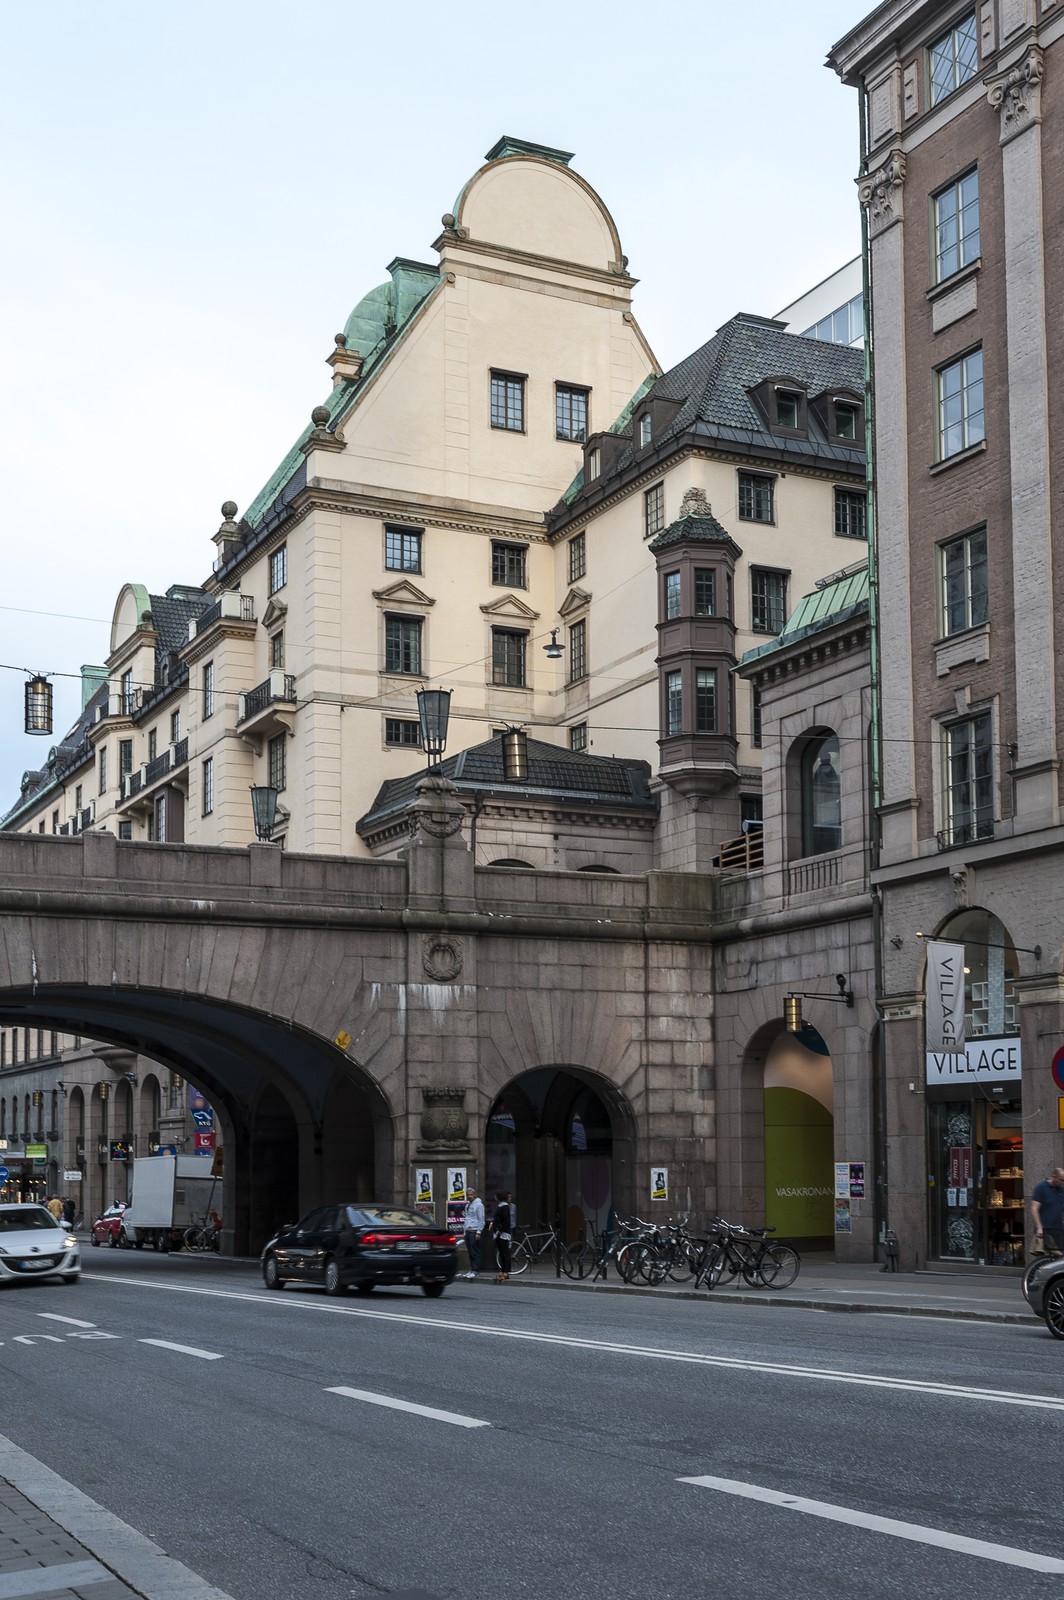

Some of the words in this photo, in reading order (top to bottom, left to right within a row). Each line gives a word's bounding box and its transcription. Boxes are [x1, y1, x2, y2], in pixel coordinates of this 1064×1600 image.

[940, 957, 956, 1046] VILLAGE
[933, 1047, 1017, 1075] VILLAGE
[775, 1187, 835, 1197] VASAKRONAN
